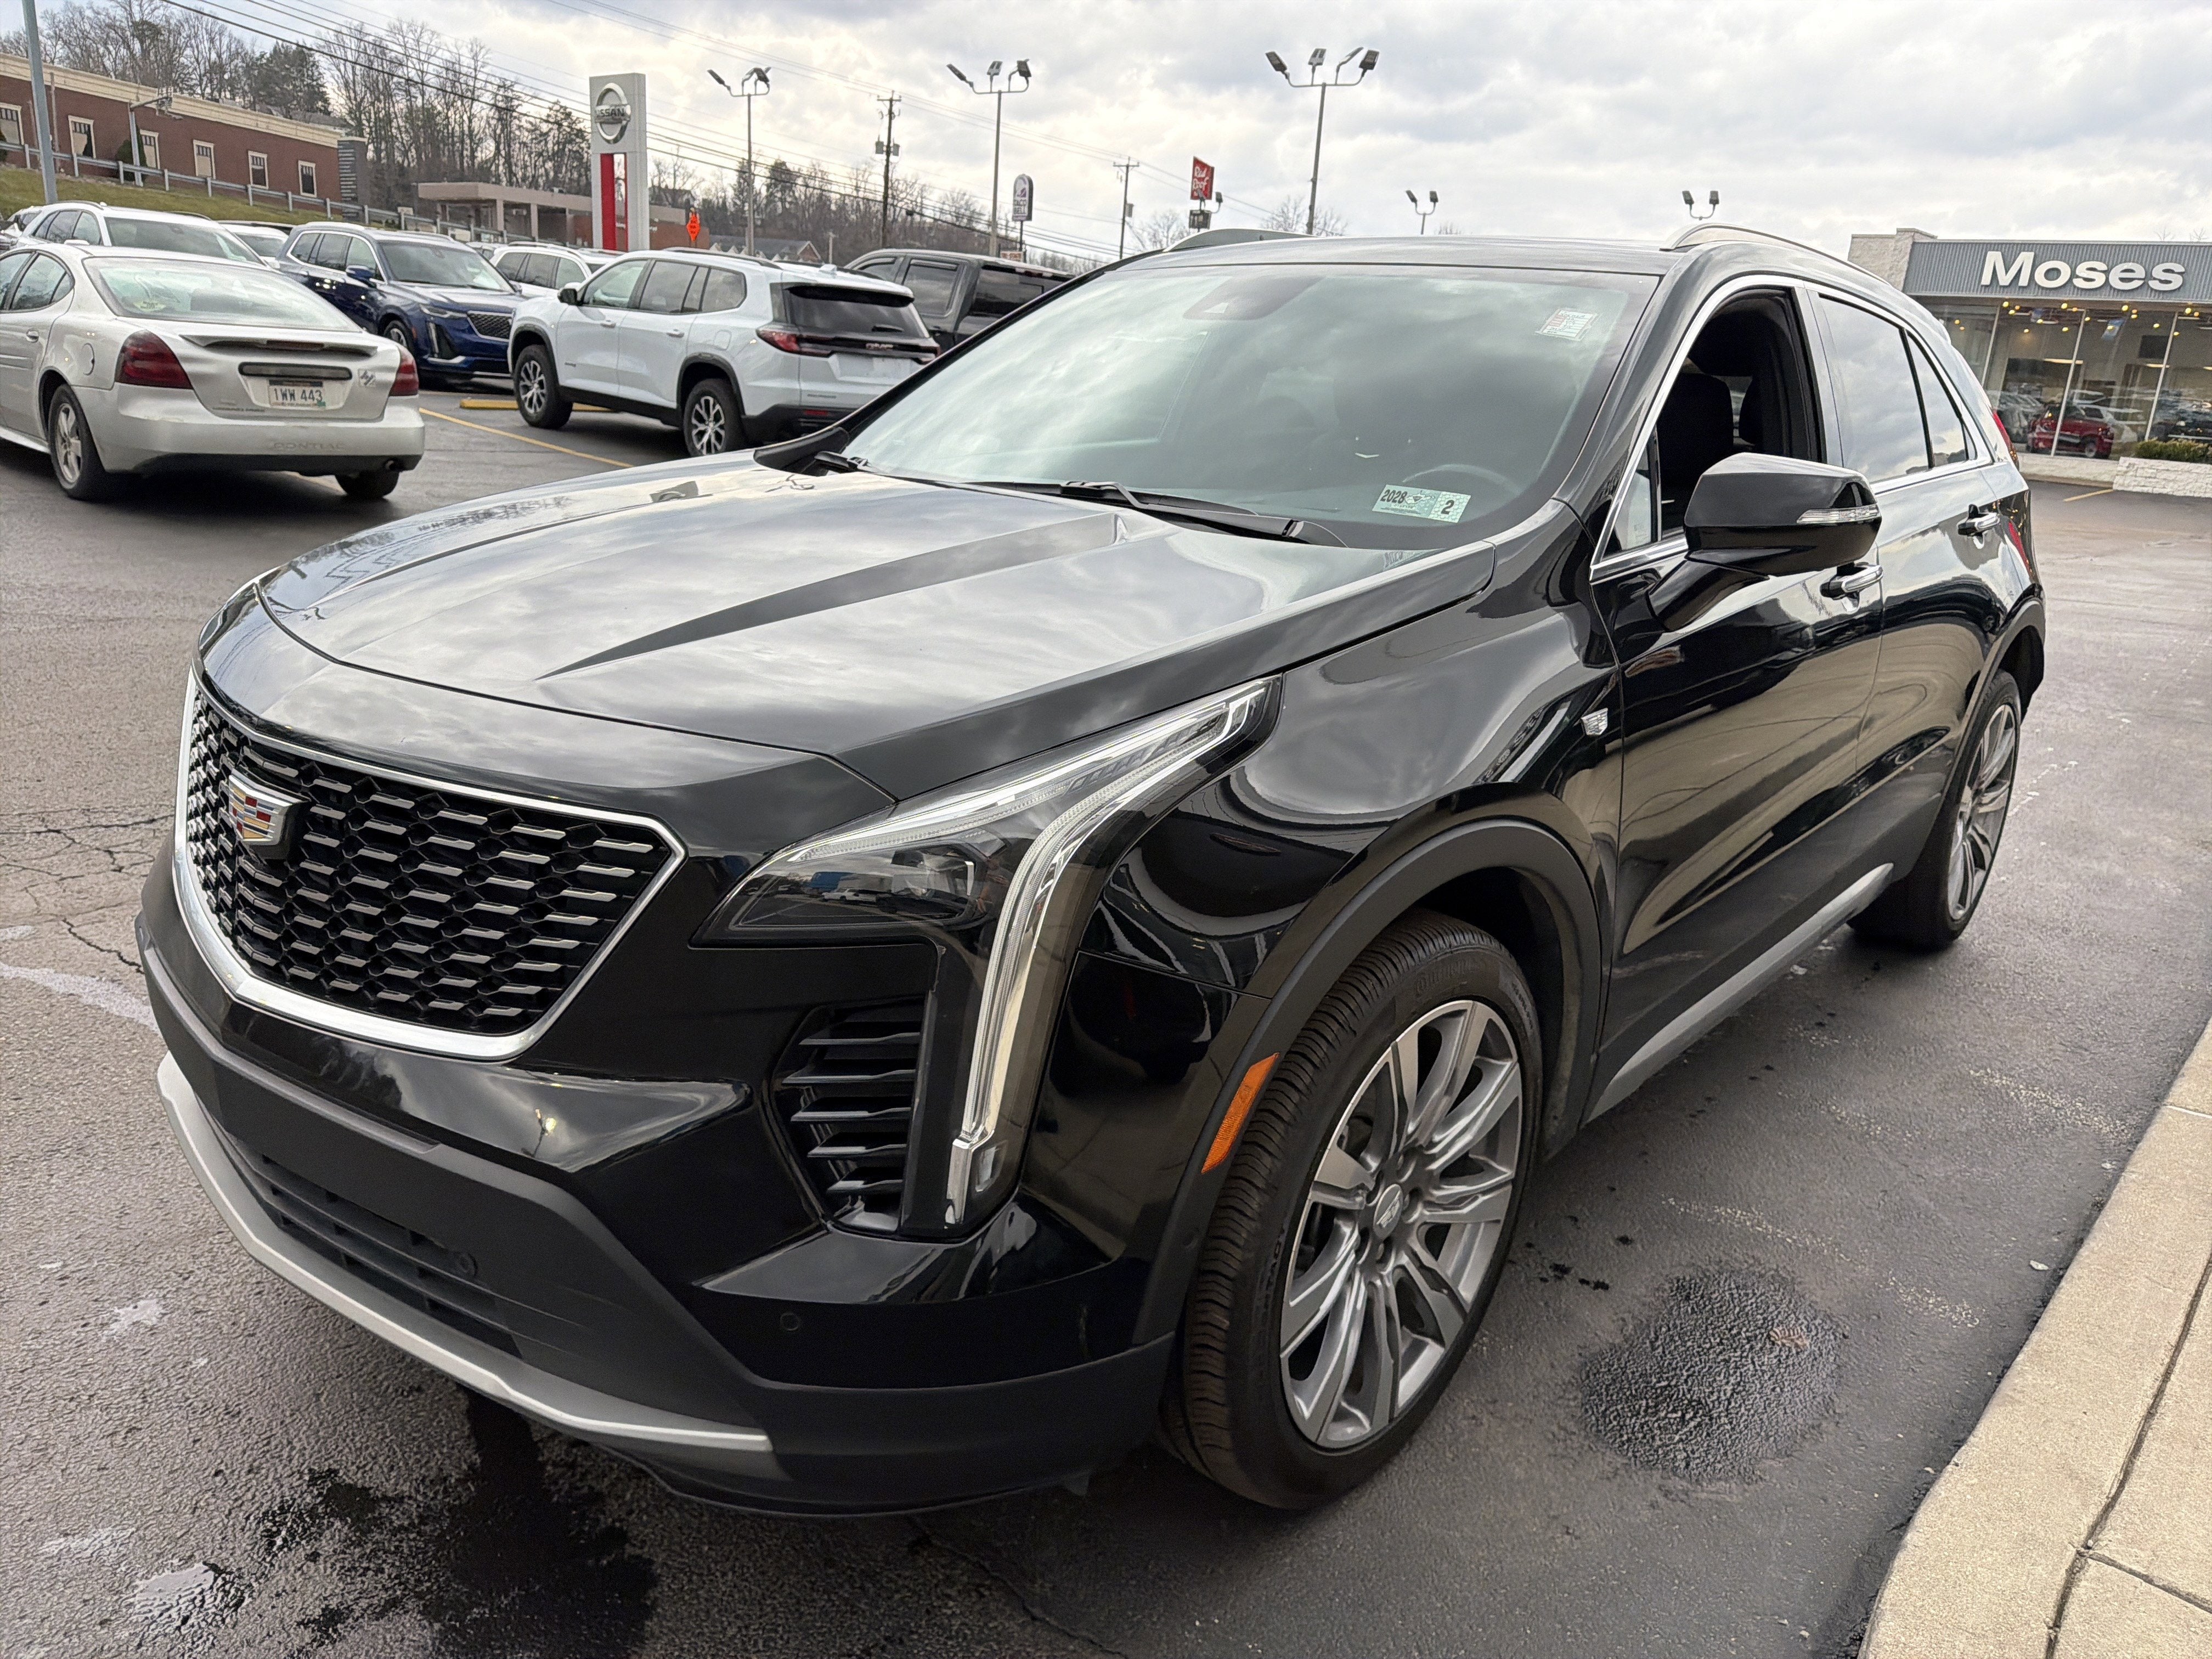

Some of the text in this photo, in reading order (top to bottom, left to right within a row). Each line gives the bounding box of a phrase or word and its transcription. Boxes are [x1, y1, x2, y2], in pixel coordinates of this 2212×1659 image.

[594, 108, 625, 117] SSAN
[1980, 250, 2186, 291] Moses
[301, 389, 324, 402] 443
[1380, 489, 1455, 515] 2028 2
